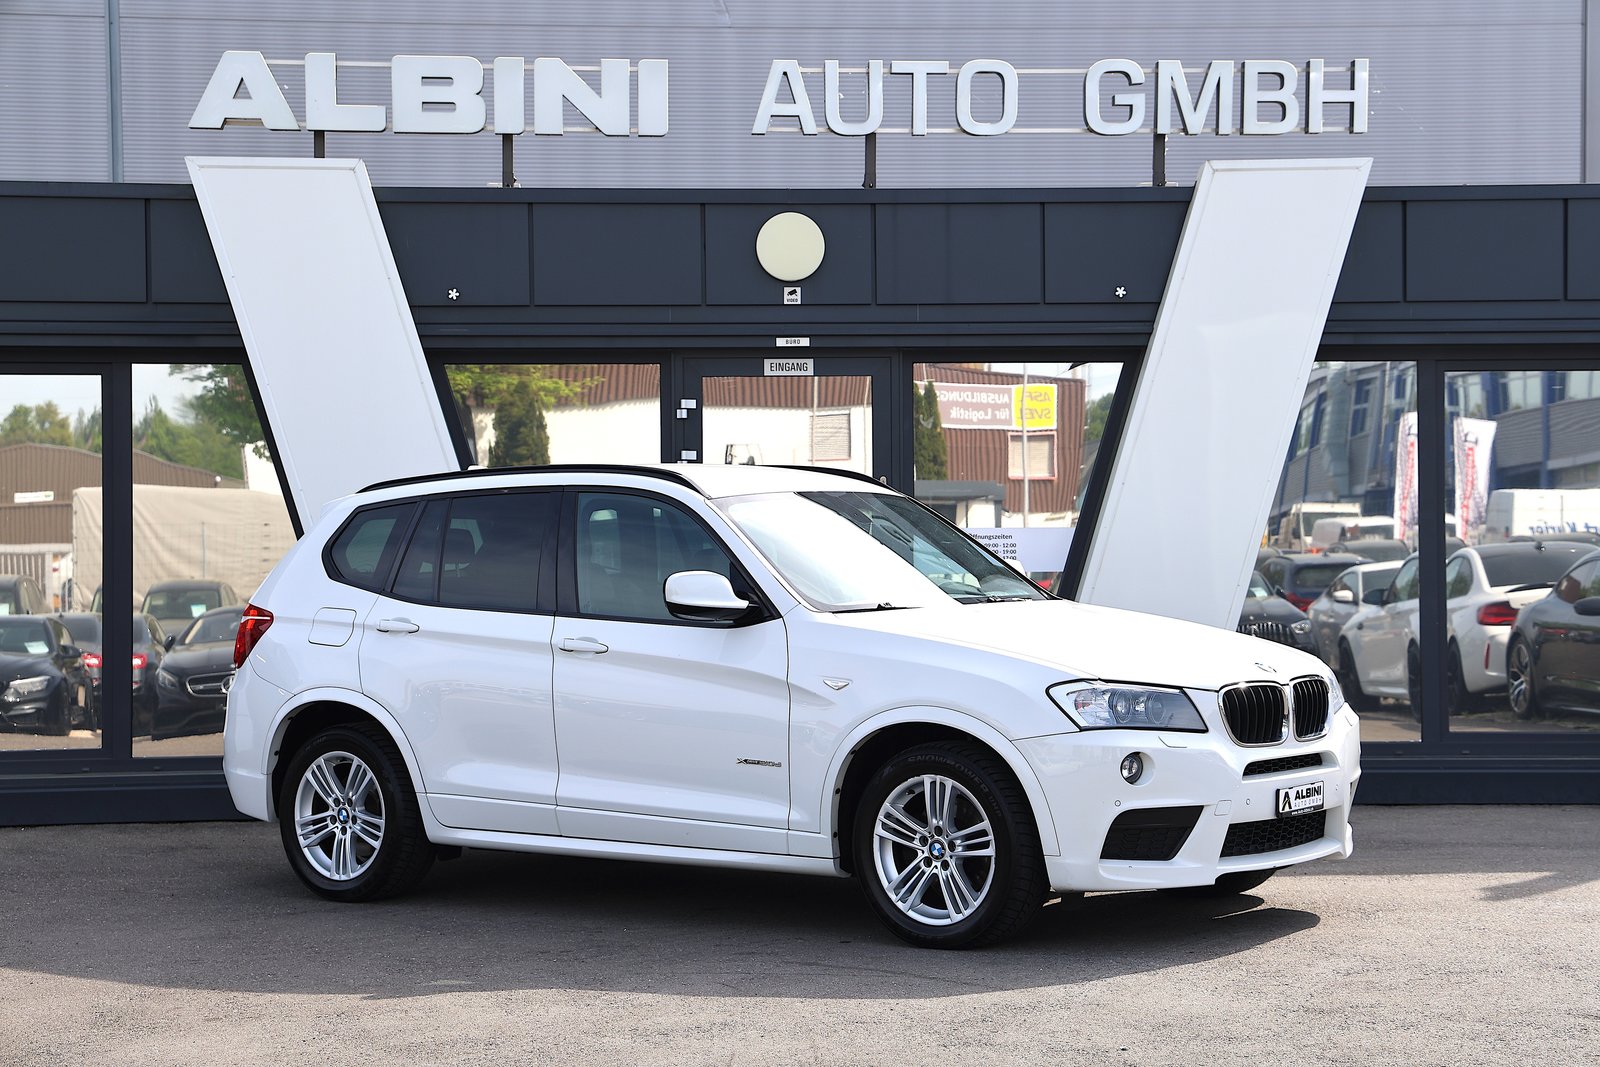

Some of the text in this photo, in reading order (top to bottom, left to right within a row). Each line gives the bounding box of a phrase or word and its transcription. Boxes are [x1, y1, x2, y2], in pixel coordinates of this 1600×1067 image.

[188, 50, 1370, 137] ALBINI AUTO GMBH
[769, 362, 808, 372] EINGANG
[1294, 785, 1322, 801] ALBINI
